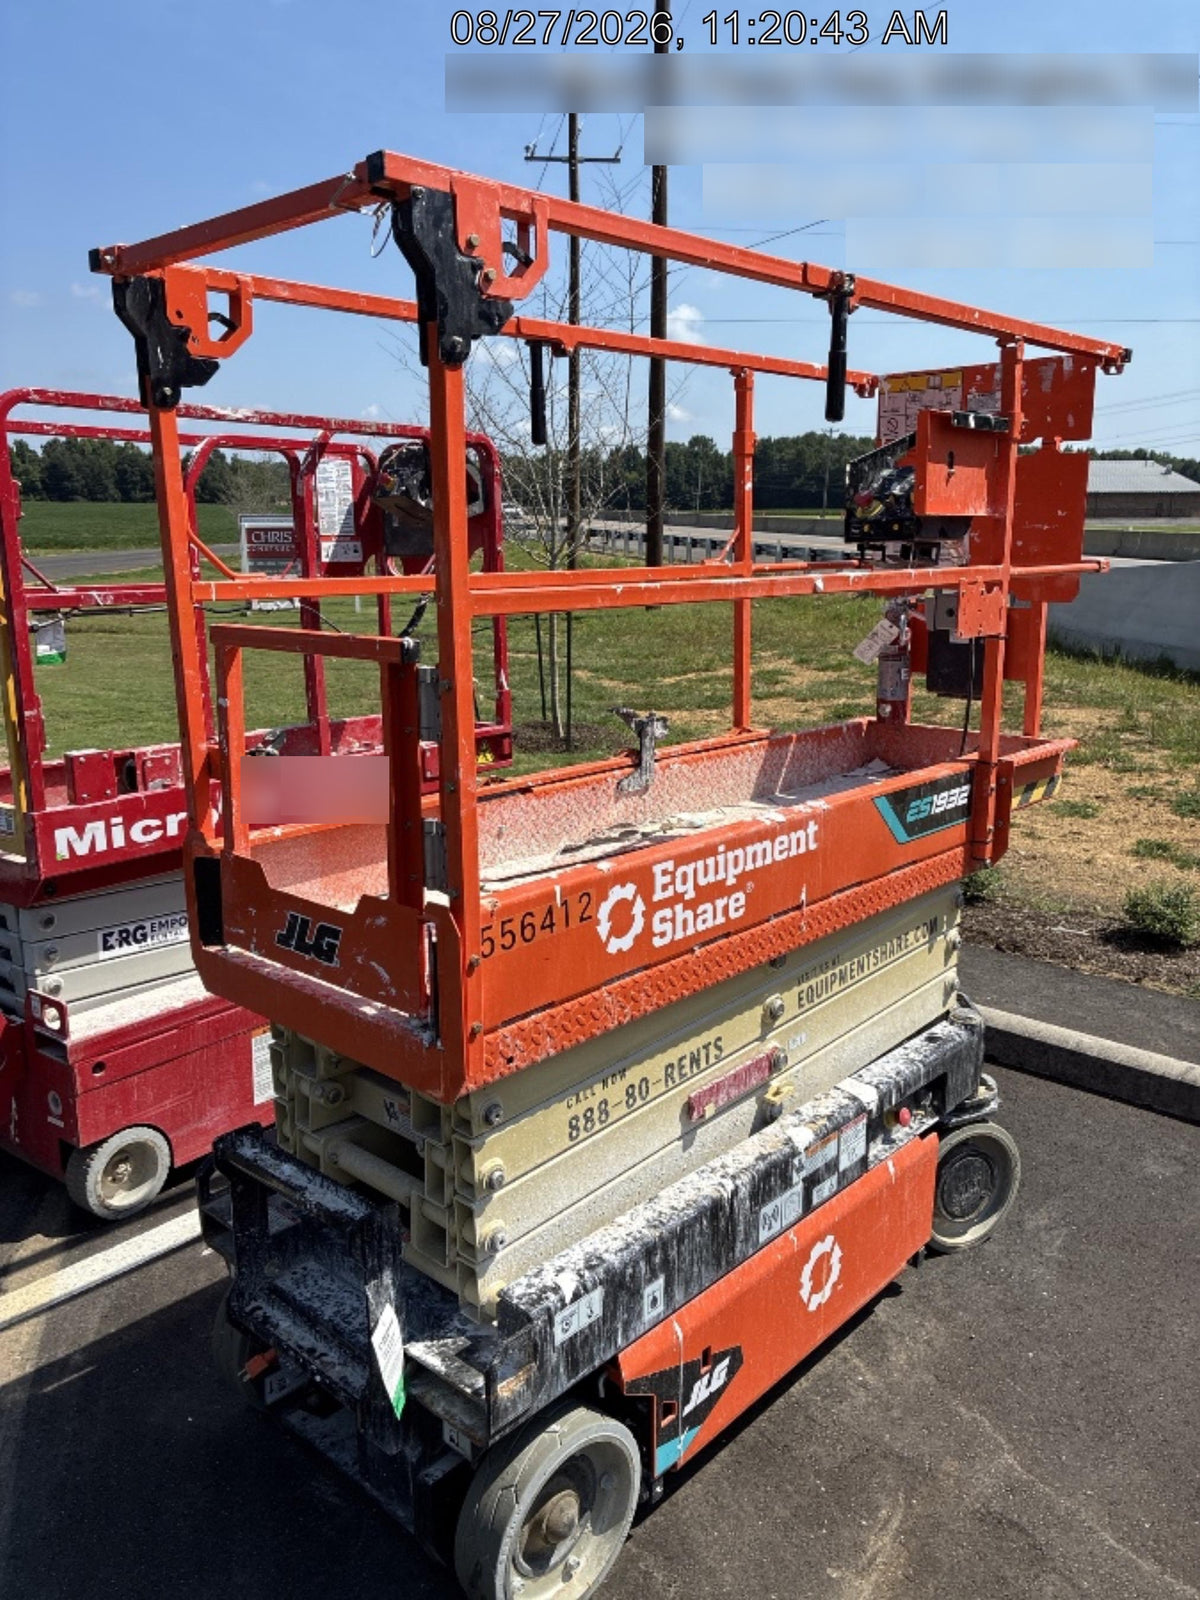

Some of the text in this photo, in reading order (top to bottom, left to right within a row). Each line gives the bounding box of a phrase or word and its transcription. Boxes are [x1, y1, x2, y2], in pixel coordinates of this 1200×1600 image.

[906, 784, 972, 823] ES1932
[54, 806, 219, 861] Micr
[652, 820, 819, 902] Equipment
[275, 911, 344, 968] JLG
[480, 891, 592, 958] 556412
[566, 1067, 628, 1110] CALL NOW
[568, 1036, 724, 1142] 888-80-RENTS
[682, 1356, 731, 1418] JLG
